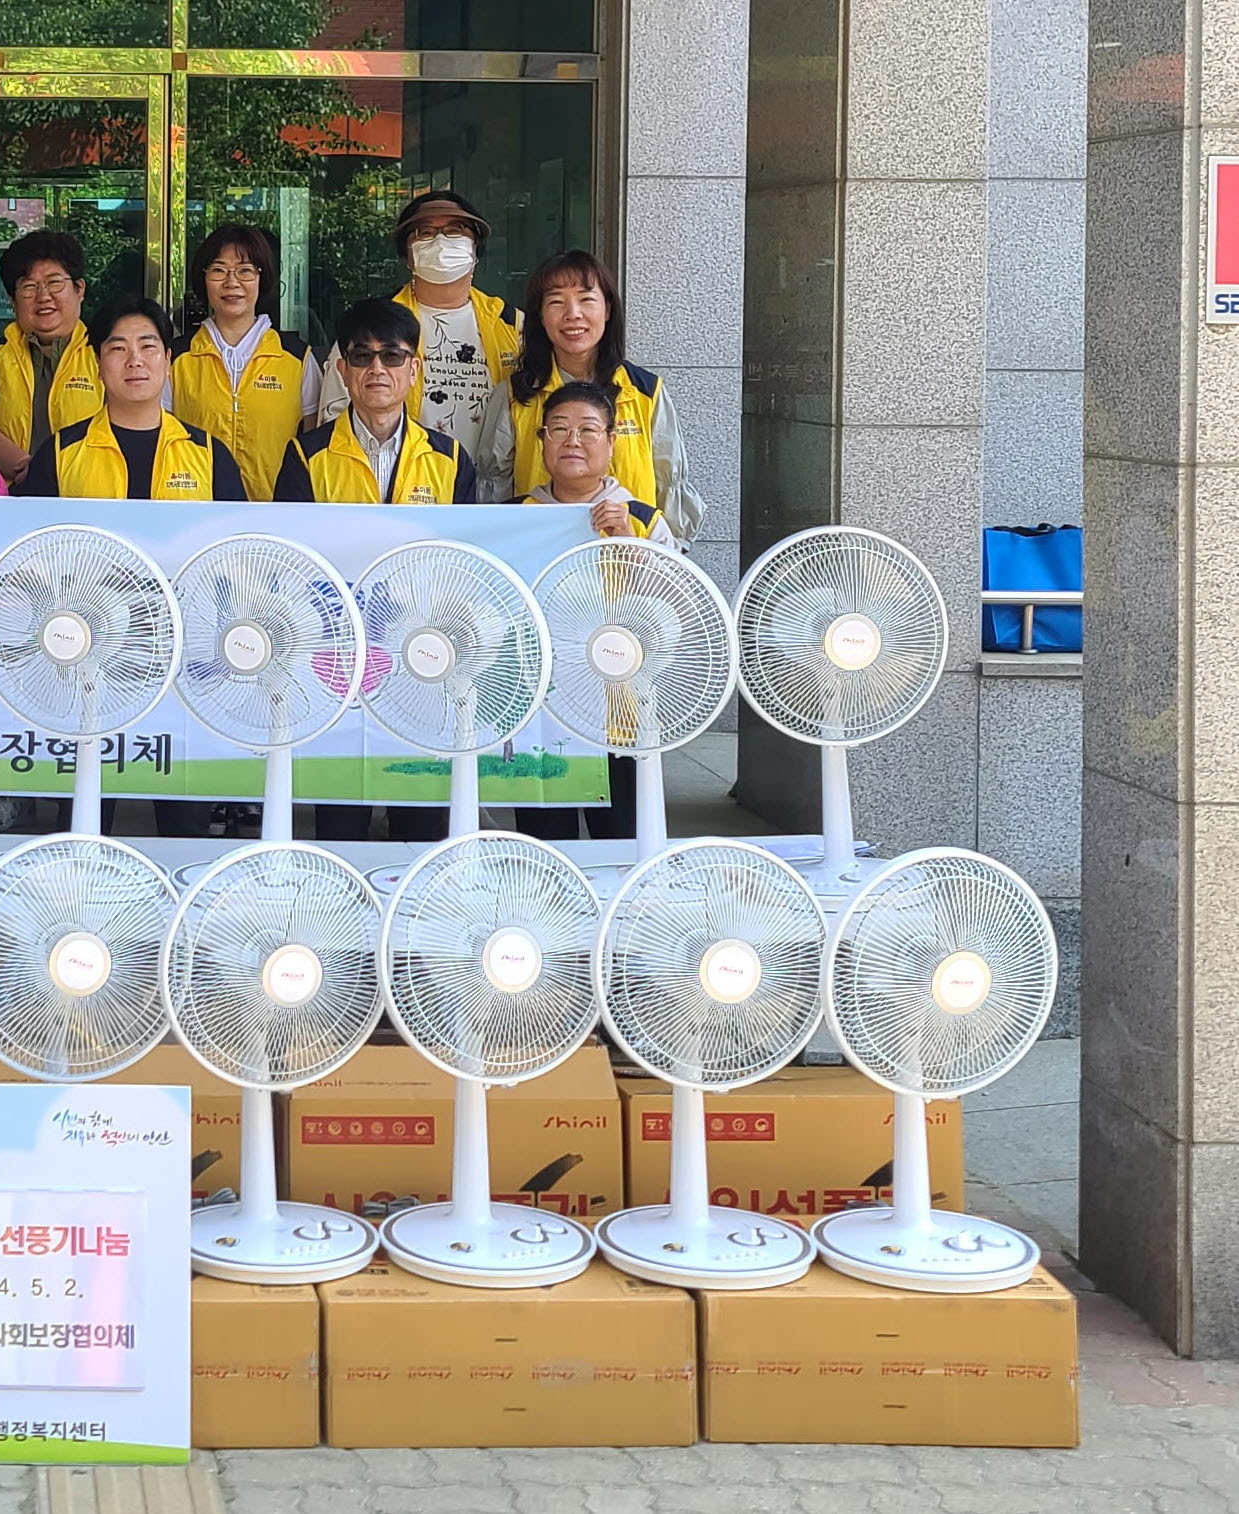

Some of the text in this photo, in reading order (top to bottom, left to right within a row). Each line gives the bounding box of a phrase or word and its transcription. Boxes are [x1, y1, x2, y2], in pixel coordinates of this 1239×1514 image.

[430, 365, 487, 377] know what
[471, 379, 489, 390] and
[544, 1116, 607, 1129] Shinil
[31, 1277, 50, 1298] 5.
[65, 1277, 84, 1298] 2.
